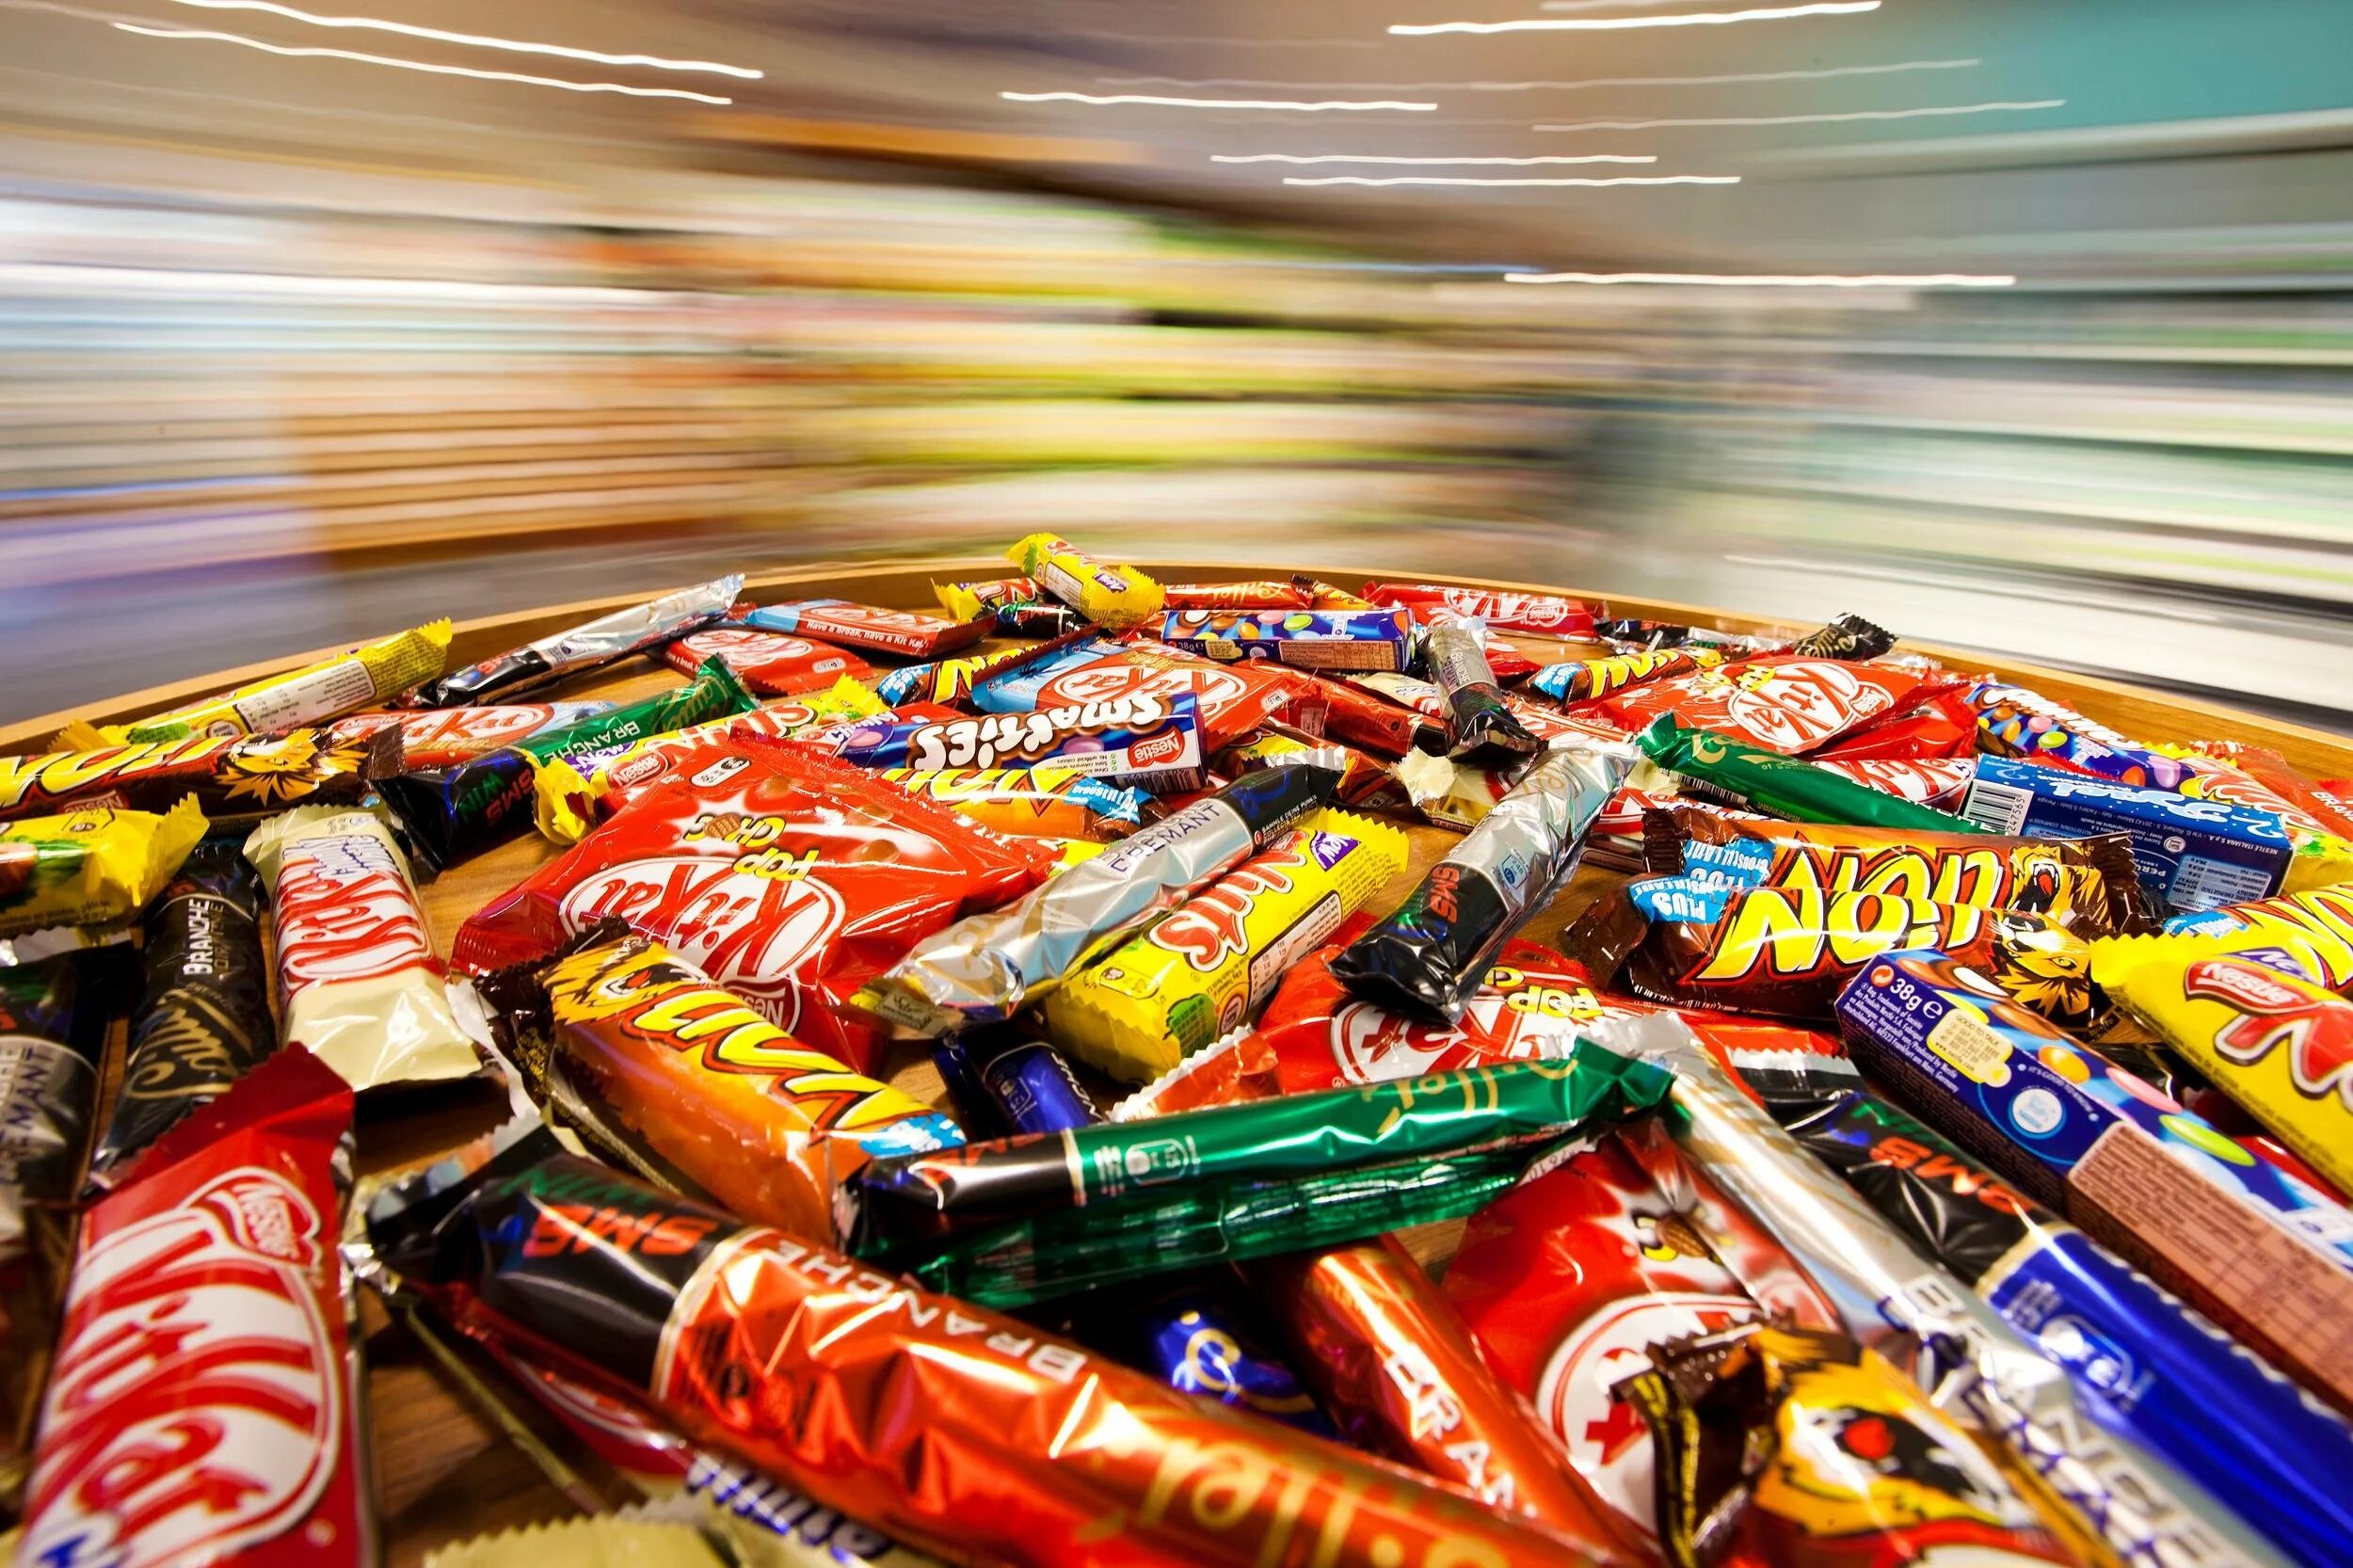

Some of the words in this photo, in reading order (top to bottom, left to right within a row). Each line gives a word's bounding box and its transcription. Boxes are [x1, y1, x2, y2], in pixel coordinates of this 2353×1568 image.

[807, 620, 823, 632] Have
[542, 721, 641, 766] BRANCHE
[1132, 736, 1180, 762] Nestlé
[1651, 891, 1706, 921] PLUS
[183, 898, 212, 976] BRANCHE
[1875, 992, 1901, 1015] Trademark
[1885, 974, 1926, 1013] 38g
[760, 1238, 1088, 1384] BRANCHE
